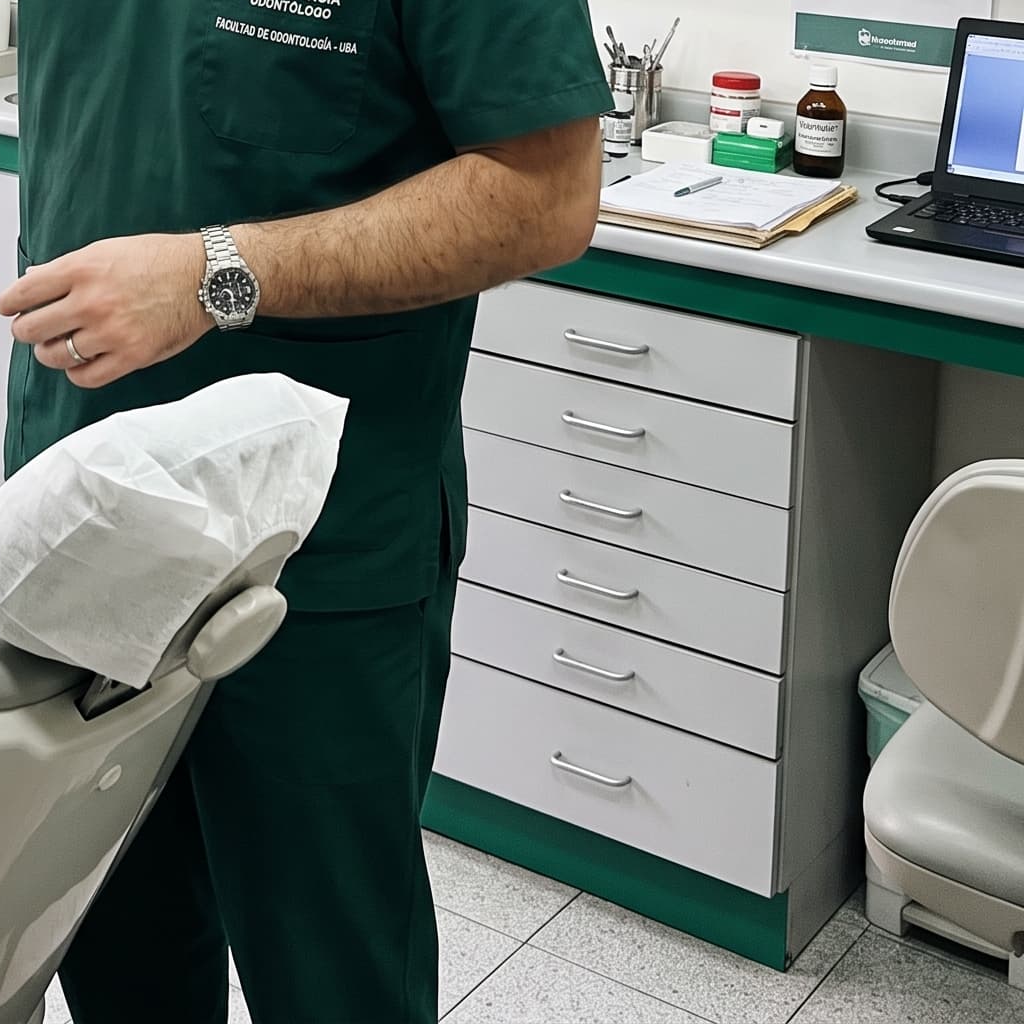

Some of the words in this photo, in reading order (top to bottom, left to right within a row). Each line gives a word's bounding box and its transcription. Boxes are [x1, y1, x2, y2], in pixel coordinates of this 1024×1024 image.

[215, 16, 256, 36] FACULTAD
[257, 27, 270, 40] DE
[270, 30, 332, 51] ODONTOLOGÍA
[339, 41, 358, 55] UBA
